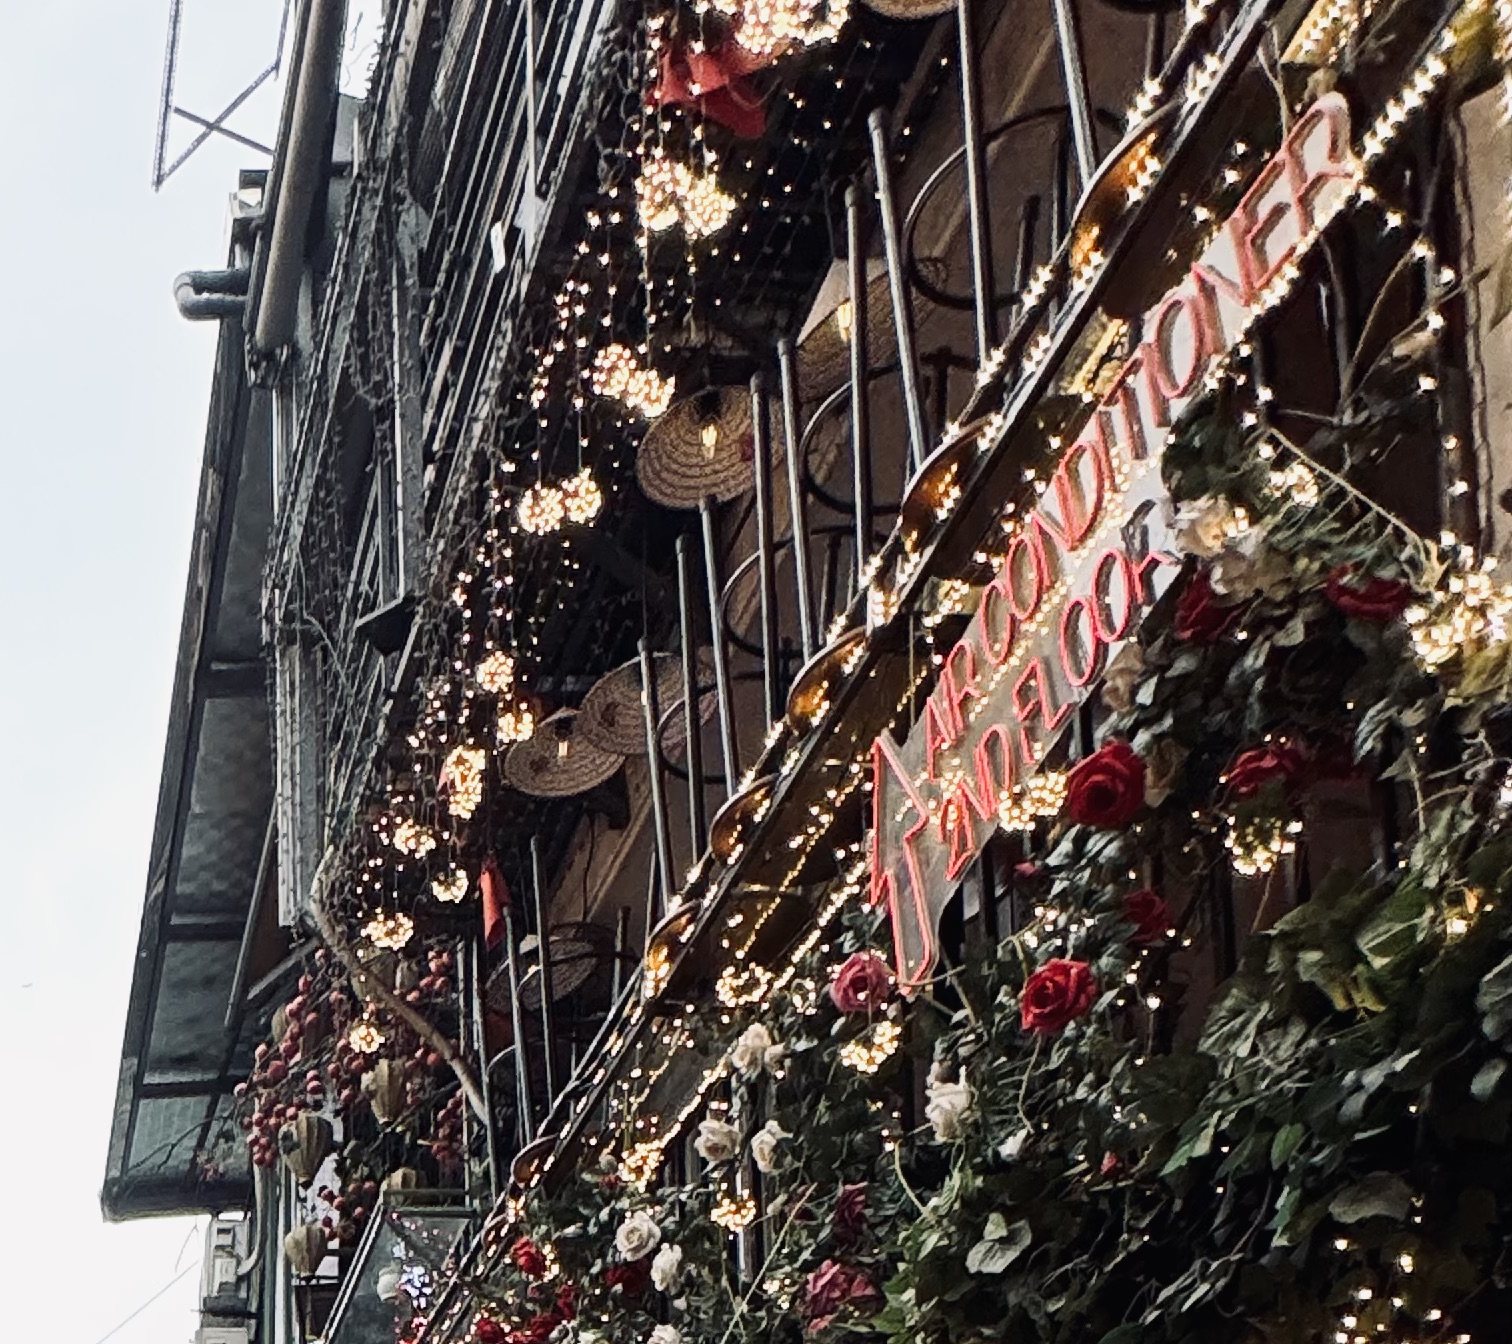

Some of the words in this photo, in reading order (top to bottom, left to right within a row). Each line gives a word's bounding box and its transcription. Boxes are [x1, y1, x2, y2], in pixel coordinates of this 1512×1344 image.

[925, 639, 980, 781] AIR
[980, 91, 1353, 665] CONDITIONER
[938, 724, 1013, 881] 2ND
[1012, 500, 1182, 766] FLOOR
